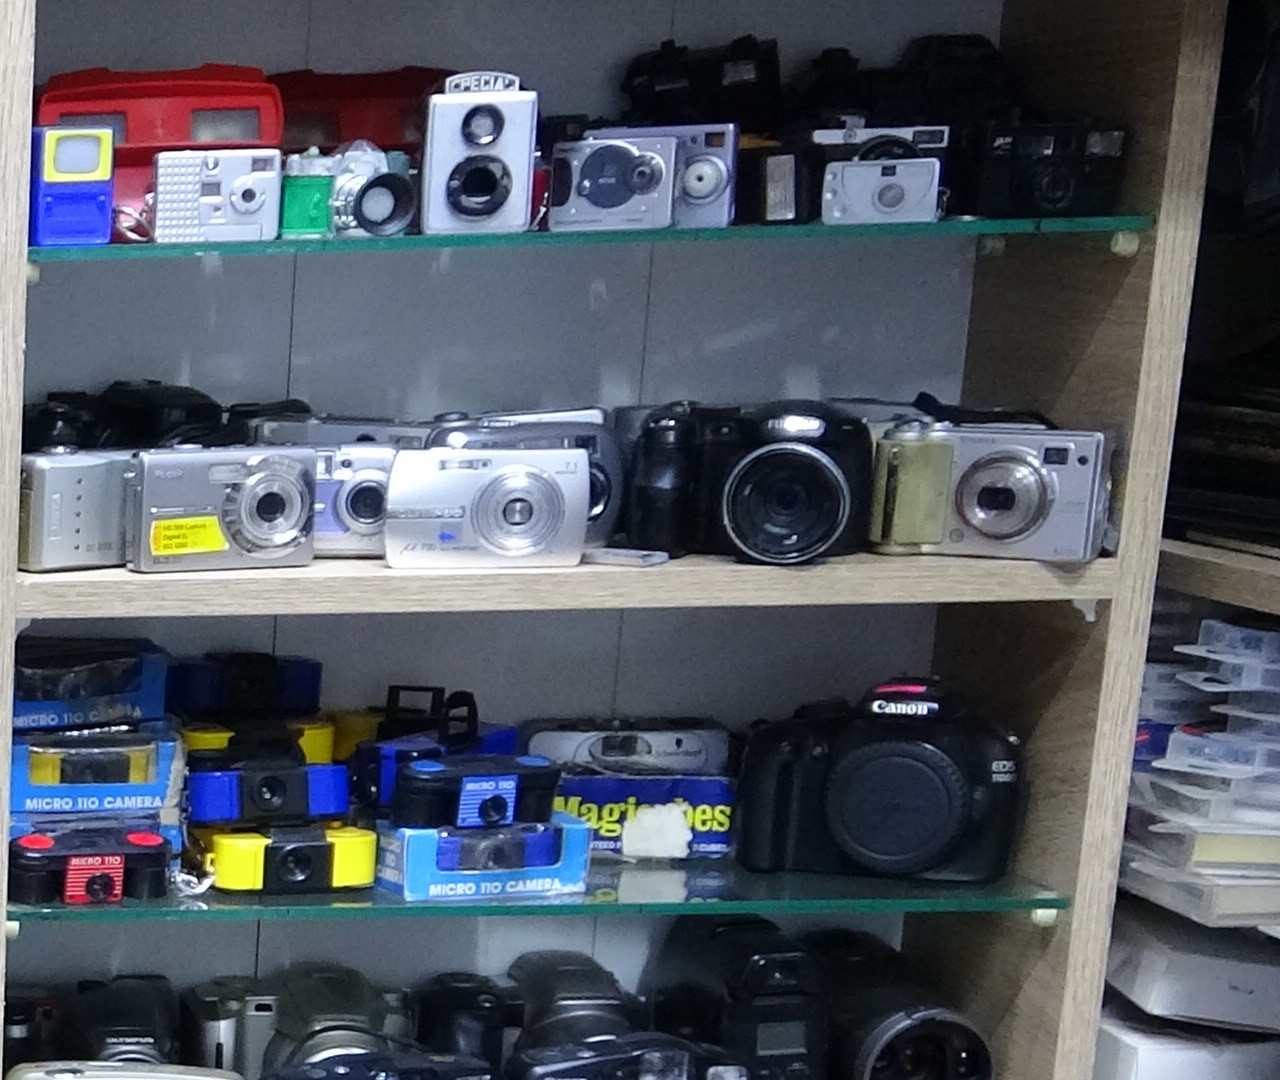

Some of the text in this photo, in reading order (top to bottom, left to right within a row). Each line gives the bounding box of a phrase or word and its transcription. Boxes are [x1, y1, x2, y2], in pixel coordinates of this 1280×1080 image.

[872, 700, 929, 715] Canon
[25, 796, 163, 810] MICRO 110 CAMERA
[70, 855, 122, 866] MICRO 110
[429, 878, 561, 898] MICRO 110 CAMERA
